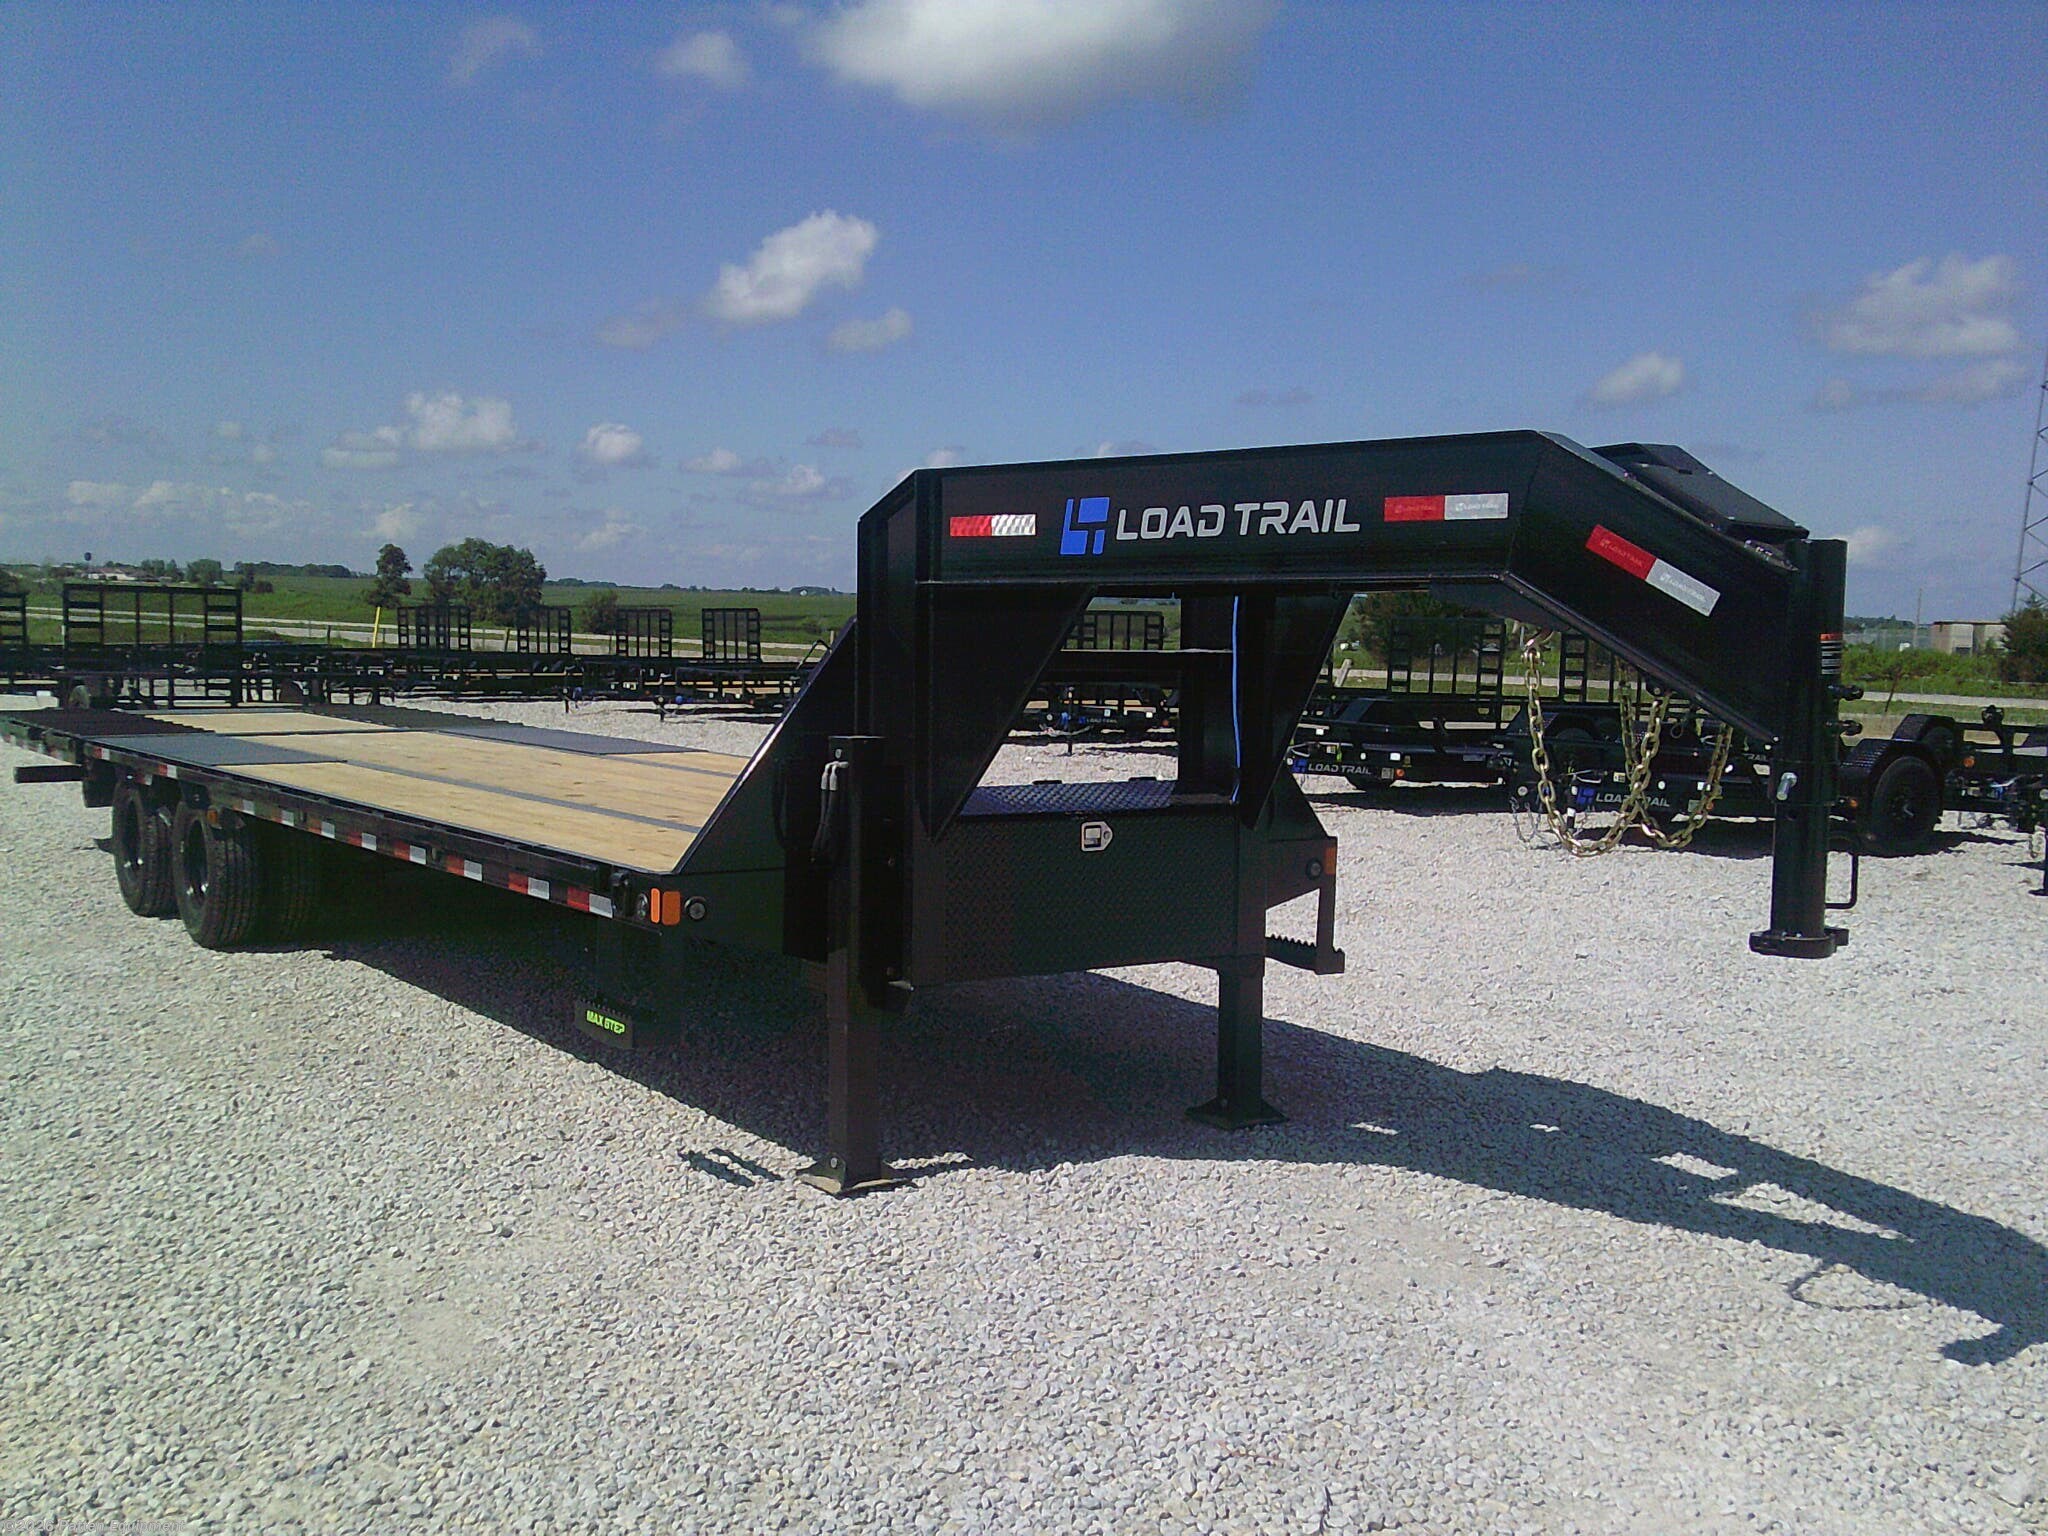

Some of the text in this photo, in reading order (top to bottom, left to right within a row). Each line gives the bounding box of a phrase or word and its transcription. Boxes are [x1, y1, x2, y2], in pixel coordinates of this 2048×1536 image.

[1115, 498, 1361, 541] LOAD TRAIL
[1308, 763, 1372, 775] LOAD TRAIL
[586, 1010, 604, 1027] MAX
